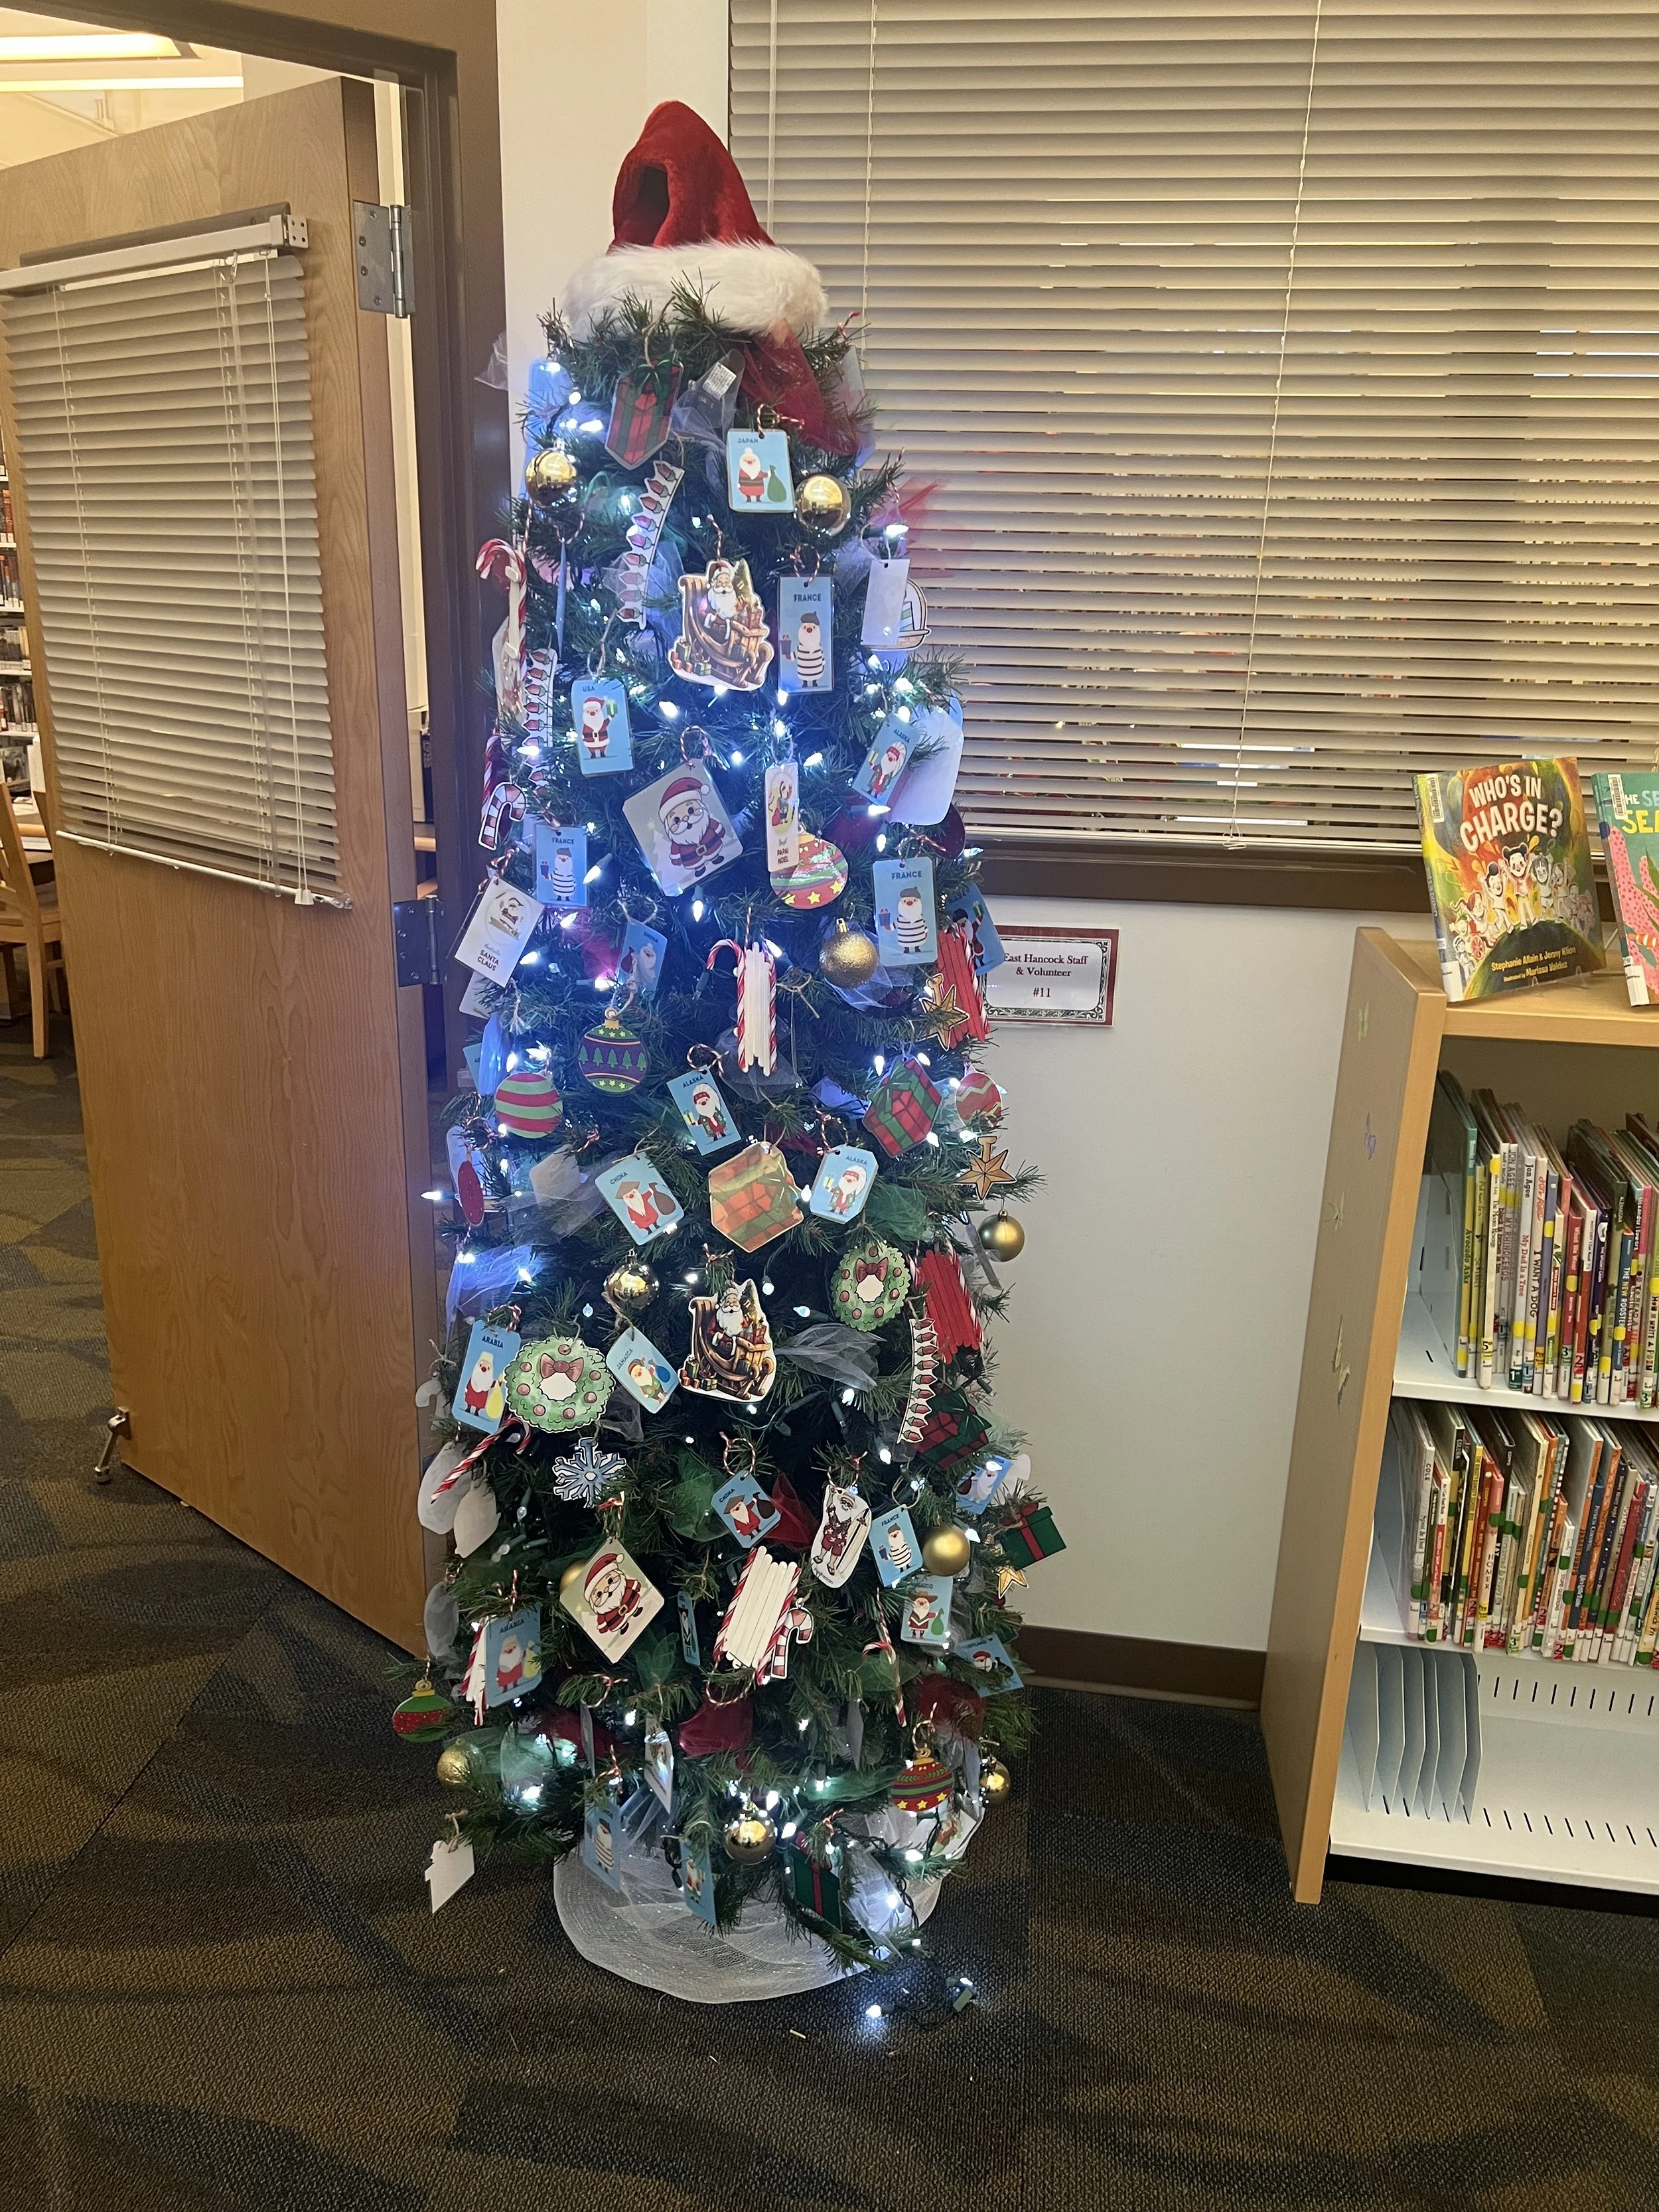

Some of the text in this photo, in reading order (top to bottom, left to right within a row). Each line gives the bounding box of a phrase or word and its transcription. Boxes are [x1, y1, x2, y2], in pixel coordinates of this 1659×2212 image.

[794, 593, 822, 602] FRANCE
[893, 729, 910, 743] ALASKA
[1469, 774, 1542, 808] WHO'S IN
[1624, 794, 1640, 805] HE
[1460, 801, 1563, 853] CHARGE?
[778, 855, 789, 865] NOEL
[891, 870, 922, 880] FRANCE
[477, 956, 496, 971] CLAUS
[480, 950, 499, 966] SANTA
[1004, 953, 1089, 964] East Hancock Staff
[1491, 957, 1522, 972] Stephanie
[1522, 954, 1539, 964] Allain
[1544, 950, 1561, 959] Jenny
[1016, 966, 1072, 976] & Volunteer
[1526, 966, 1548, 976] Marissa
[1033, 988, 1050, 997] #11
[683, 1075, 703, 1088] ALASKA
[845, 1155, 867, 1165] ALASKA
[610, 1171, 628, 1185] CHINA
[1506, 1166, 1516, 1188] AGEE
[1523, 1163, 1534, 1198] Jon Agee
[1520, 1234, 1530, 1246] My
[1462, 1229, 1473, 1284] Avocado Asks
[1499, 1217, 1514, 1282] MY RHINOCEROS
[1572, 1244, 1579, 1254] We
[1531, 1259, 1542, 1283] WANT
[1621, 1282, 1630, 1297] NEW
[1529, 1295, 1539, 1318] DOG
[1632, 1298, 1640, 1319] READ
[482, 1335, 504, 1349] ARABIA
[616, 1348, 634, 1370] JAMAICA
[1644, 1349, 1654, 1371] POEM
[1454, 1438, 1463, 1459] COLLIER
[719, 1489, 735, 1503] CHINA
[881, 1513, 900, 1526] FRANCE
[1419, 1514, 1427, 1530] Spot
[1586, 1505, 1600, 1552] PATRICIA CORNWELL
[1483, 1554, 1494, 1590] HOMER
[1555, 1588, 1563, 1612] QUESTIONS
